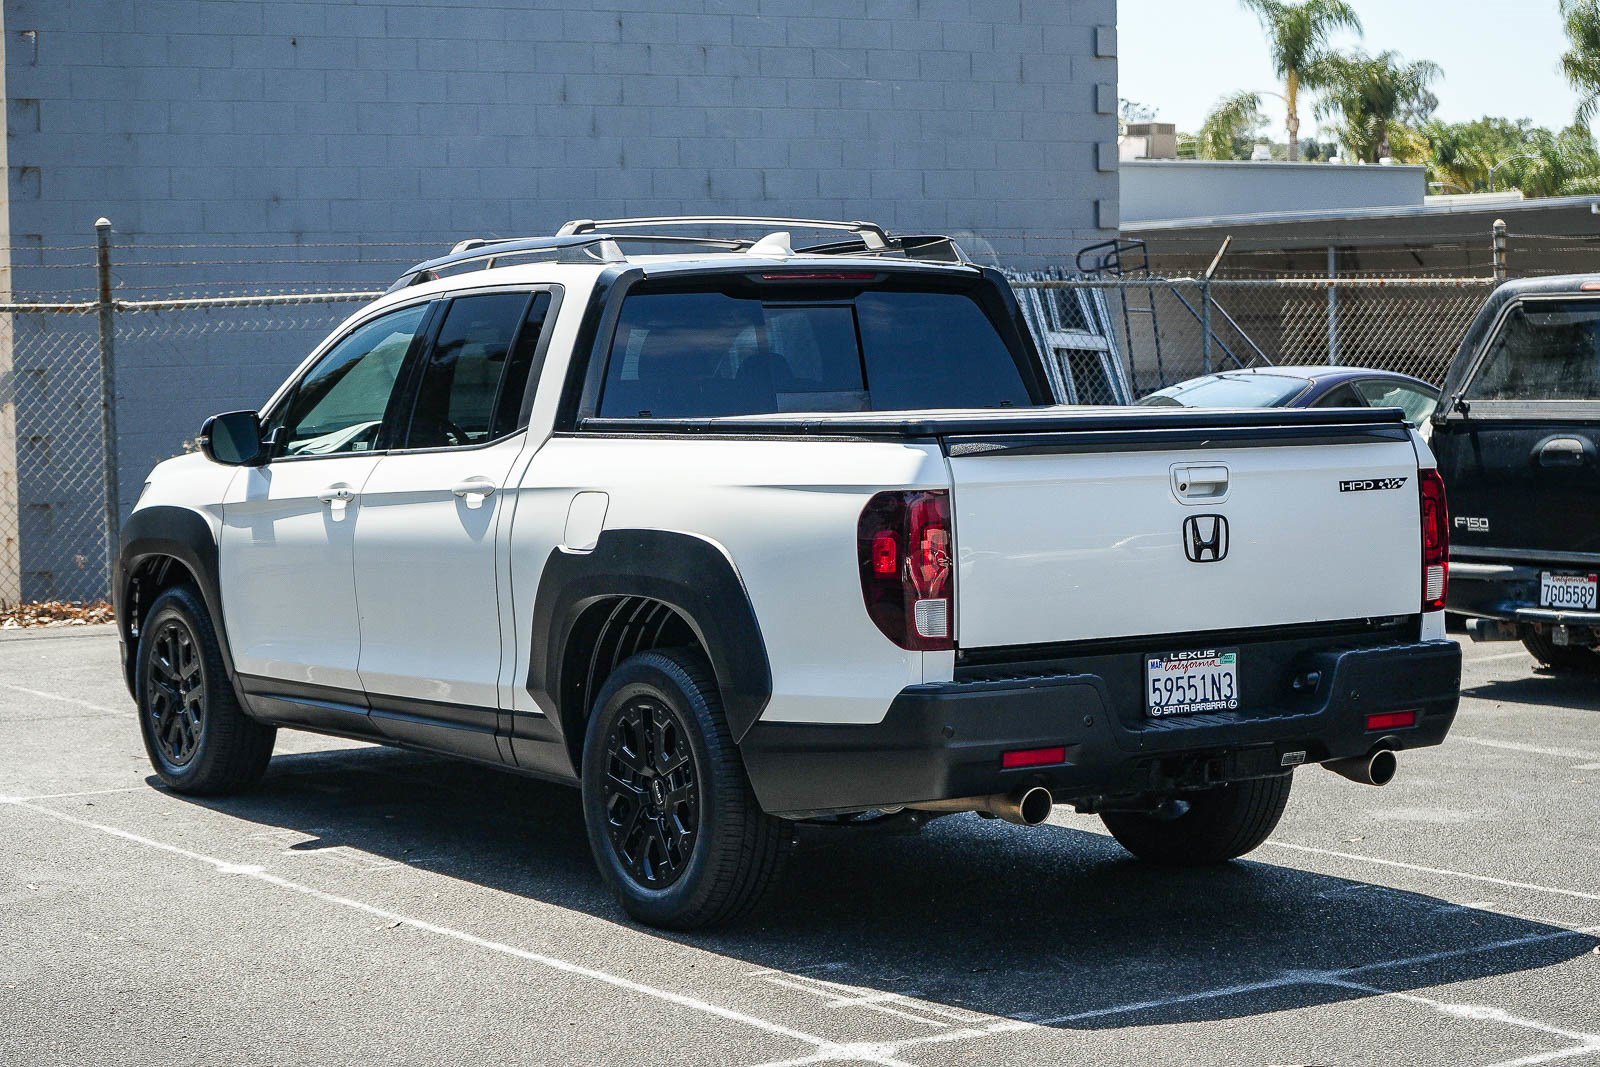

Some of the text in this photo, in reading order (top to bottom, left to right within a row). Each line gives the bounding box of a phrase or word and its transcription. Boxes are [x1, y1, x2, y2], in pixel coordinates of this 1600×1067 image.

[1341, 480, 1374, 491] HPD
[1543, 584, 1595, 605] 7G05589
[1170, 649, 1216, 660] LEXUS
[1150, 660, 1163, 670] MAR
[1164, 659, 1222, 674] California
[1152, 672, 1234, 706] 59551N3
[1163, 700, 1227, 715] SANTA BARBARA
